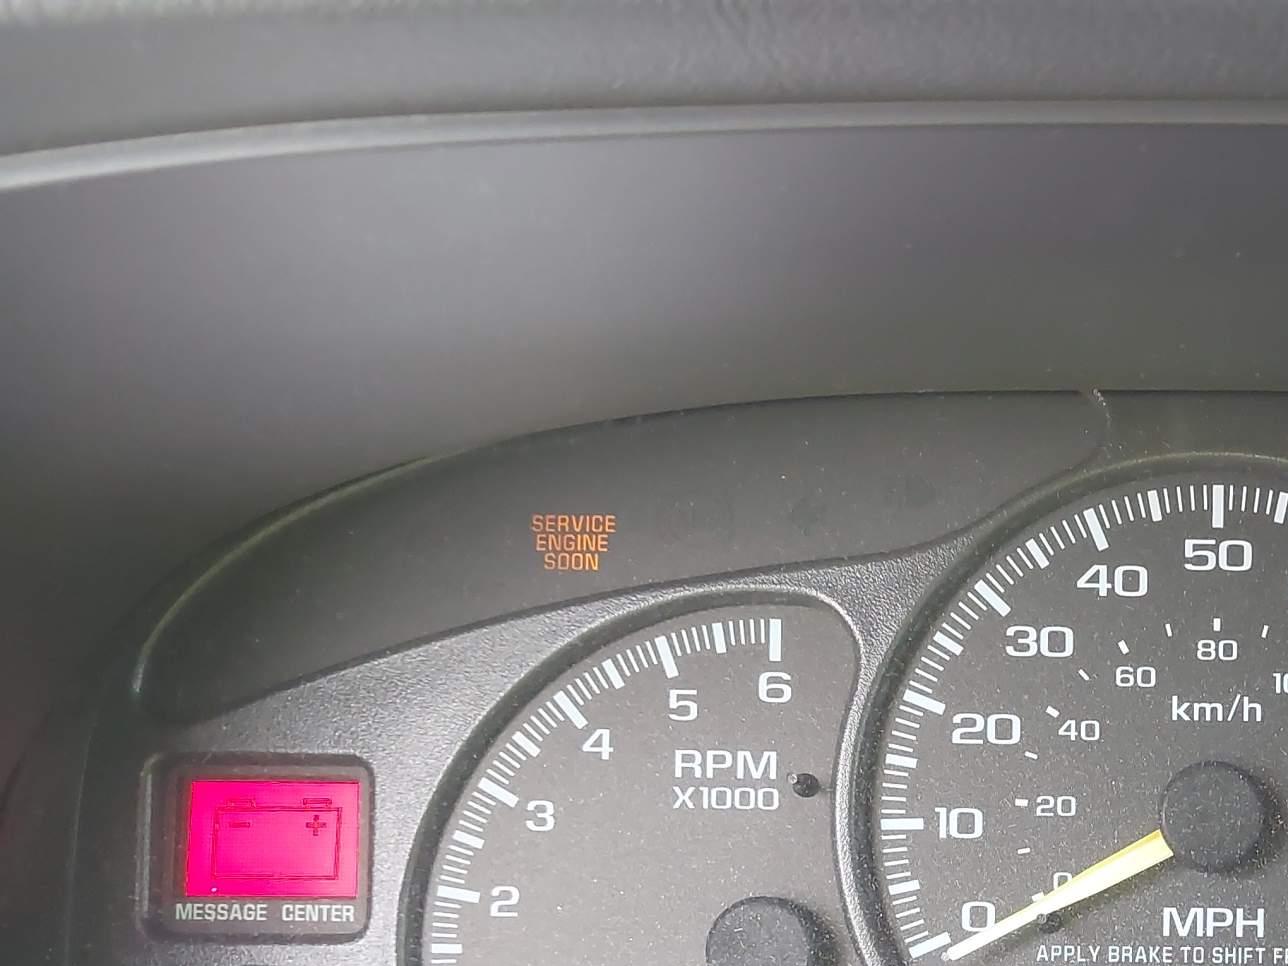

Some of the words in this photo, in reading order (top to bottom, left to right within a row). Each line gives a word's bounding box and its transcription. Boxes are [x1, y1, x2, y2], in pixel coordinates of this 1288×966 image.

[533, 515, 615, 533] SERVICE
[536, 534, 608, 552] ENGINE
[1184, 539, 1253, 572] 50
[544, 552, 599, 571] SOON
[1076, 564, 1148, 597] 40
[1005, 625, 1074, 658] 30
[1196, 639, 1238, 661] 80
[758, 671, 792, 703] 6
[1115, 666, 1156, 688] 60
[668, 689, 698, 721] 5
[1171, 693, 1262, 722] km/h
[582, 728, 614, 760] 4
[951, 713, 1021, 745] 20
[1058, 719, 1100, 741] 40
[674, 749, 777, 780] RPM
[672, 786, 780, 810] X1000
[1036, 795, 1077, 817] 20
[525, 800, 555, 832] 3
[934, 807, 983, 839] 10
[176, 903, 268, 922] MESSAGE
[282, 904, 355, 922] CENTER
[490, 885, 520, 917] 2
[961, 900, 996, 933] 0
[1162, 906, 1265, 938] MPH
[1036, 944, 1101, 963] APPLY
[1108, 944, 1173, 964] BRAKE
[1179, 945, 1205, 964] TO
[1211, 946, 1266, 966] SHIFT
